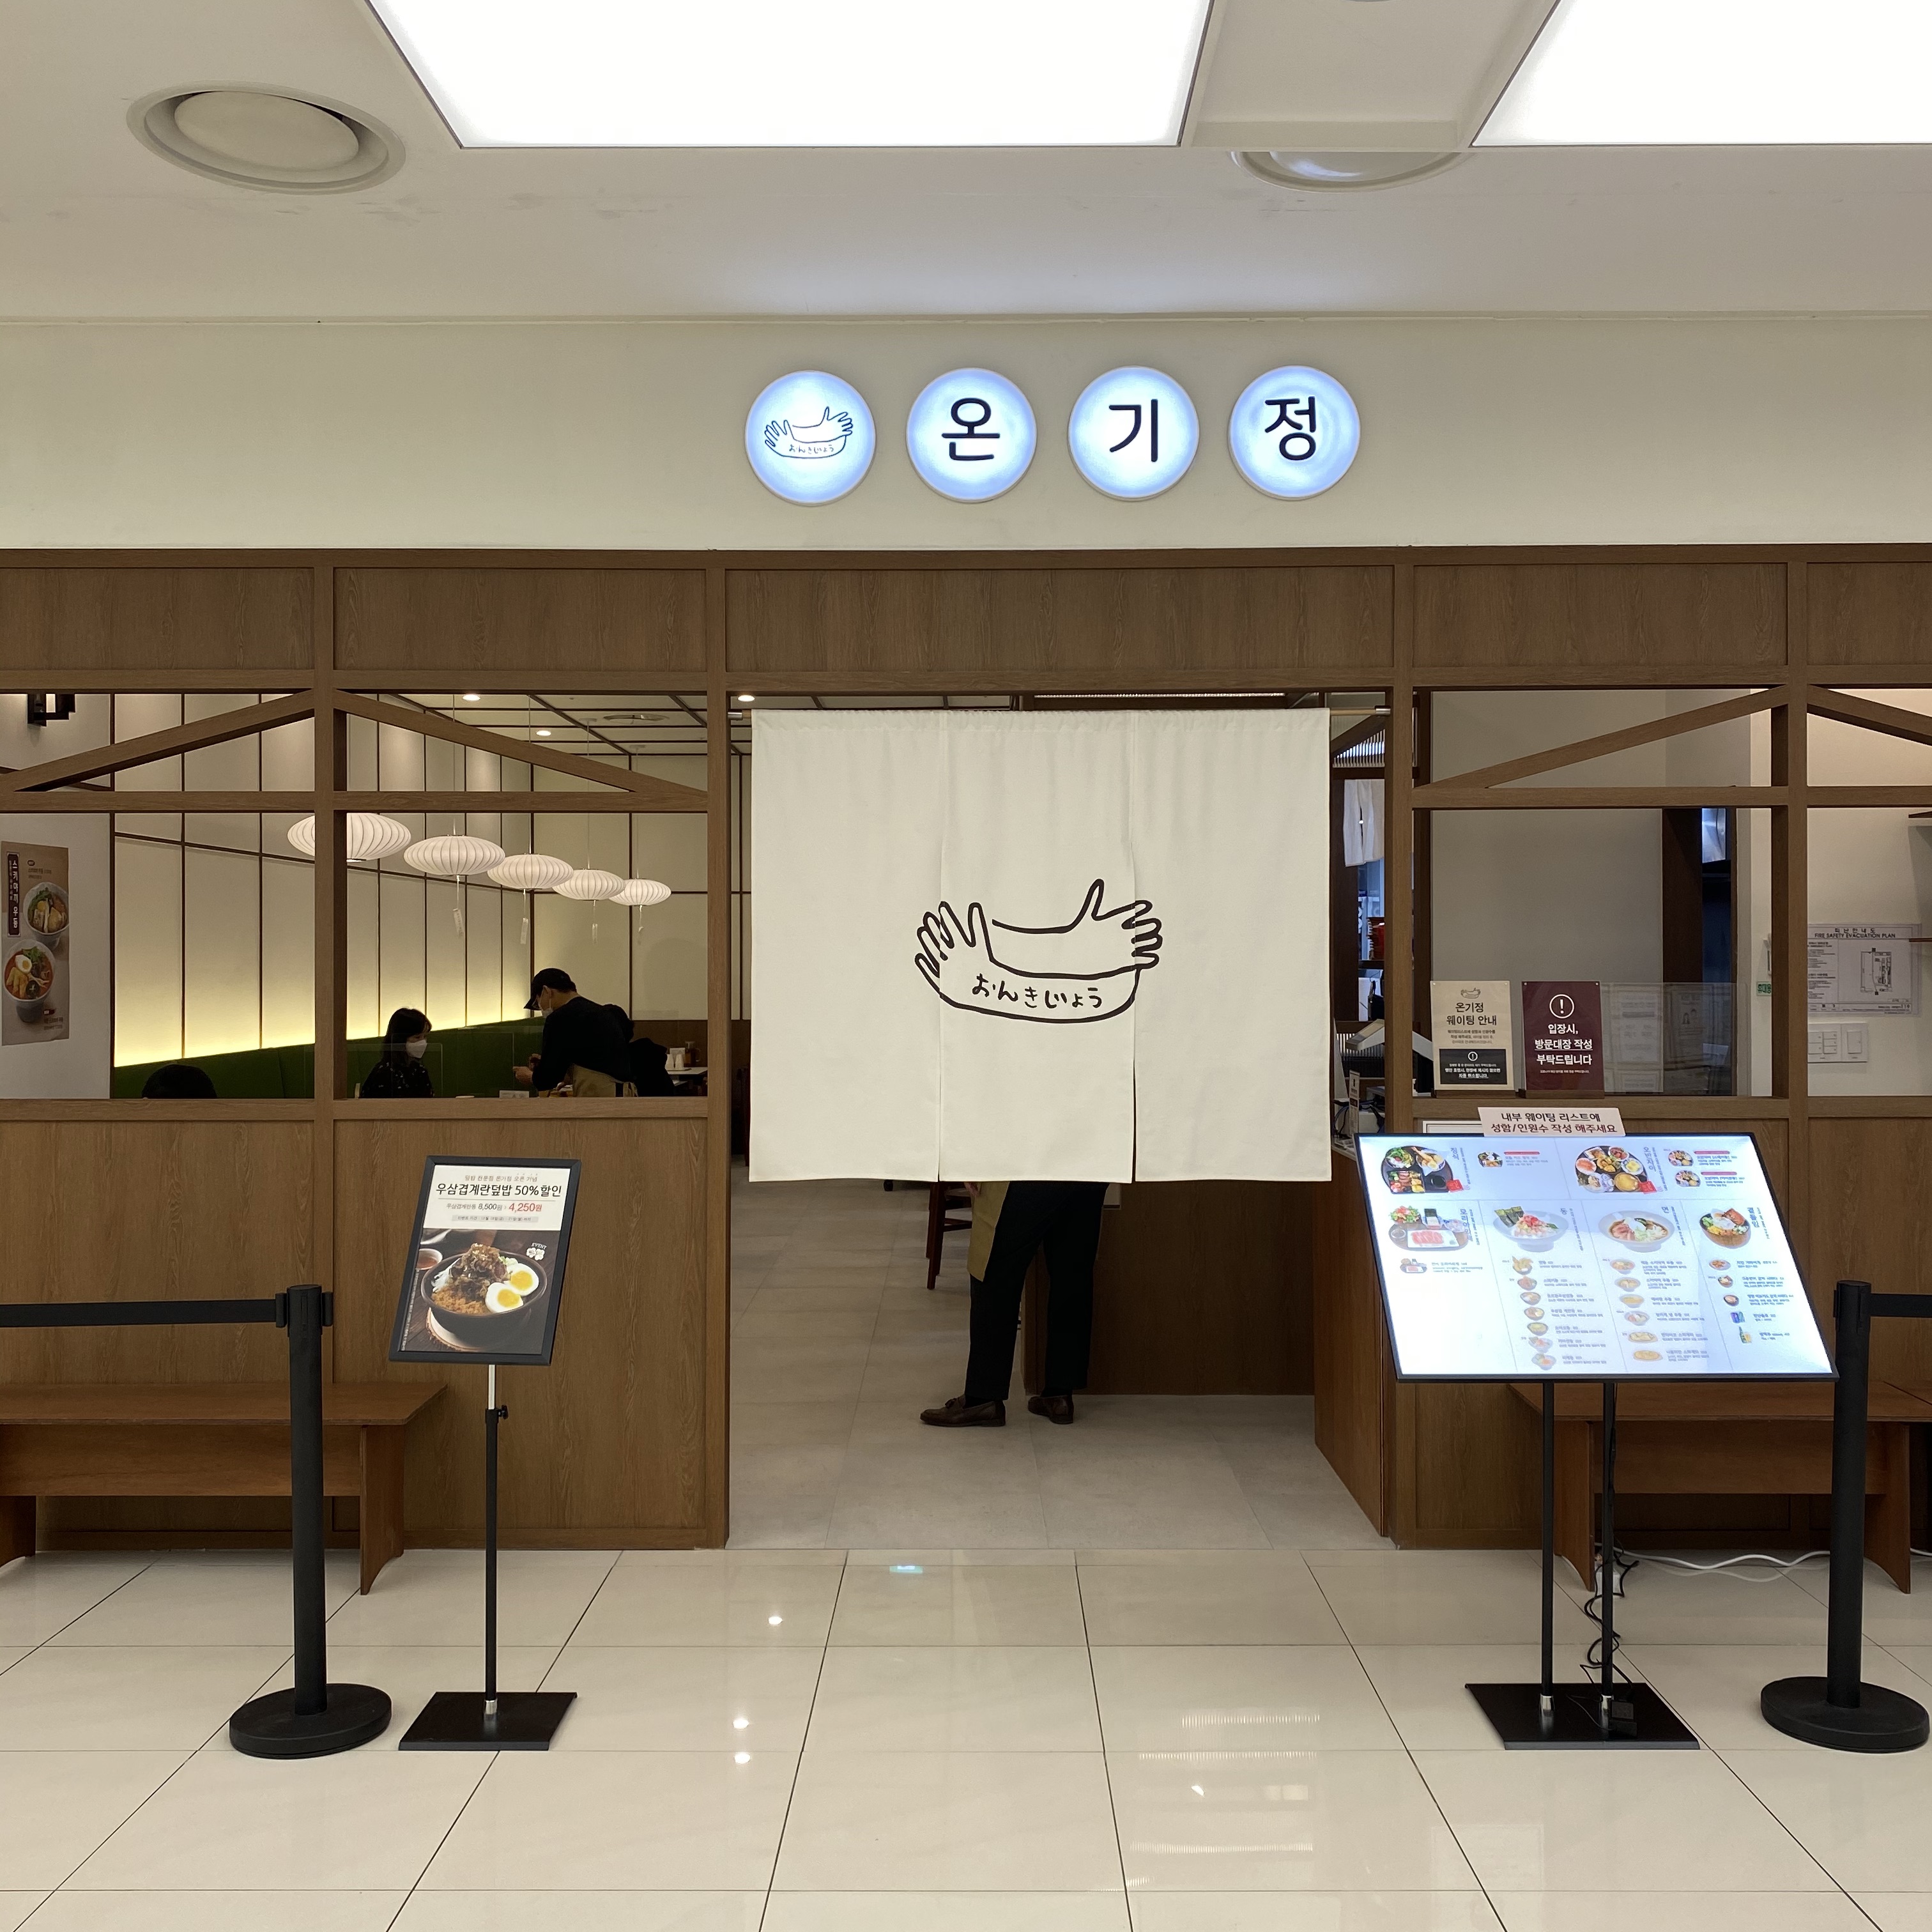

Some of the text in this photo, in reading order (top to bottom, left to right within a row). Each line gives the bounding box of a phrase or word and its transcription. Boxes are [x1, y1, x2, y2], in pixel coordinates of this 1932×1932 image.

[942, 397, 1317, 462] 온기정
[972, 973, 1102, 1009] おんきじょう
[1455, 1002, 1484, 1013] 온기정
[1446, 1015, 1497, 1026] 웨이팅 안내
[1547, 1023, 1579, 1035] 입장시,
[1534, 1039, 1593, 1050] 방문대장 작성
[1536, 1054, 1593, 1066] 부탁드립니다
[1501, 1112, 1600, 1123] 내부 웨이팅 리스트에
[1491, 1123, 1618, 1133] 성함/인원수 작성 해주세요
[436, 1183, 562, 1197] 우삼겹계란덮밥 50% 할인
[509, 1202, 542, 1213] 4,250원
[531, 1242, 548, 1250] EVENT
